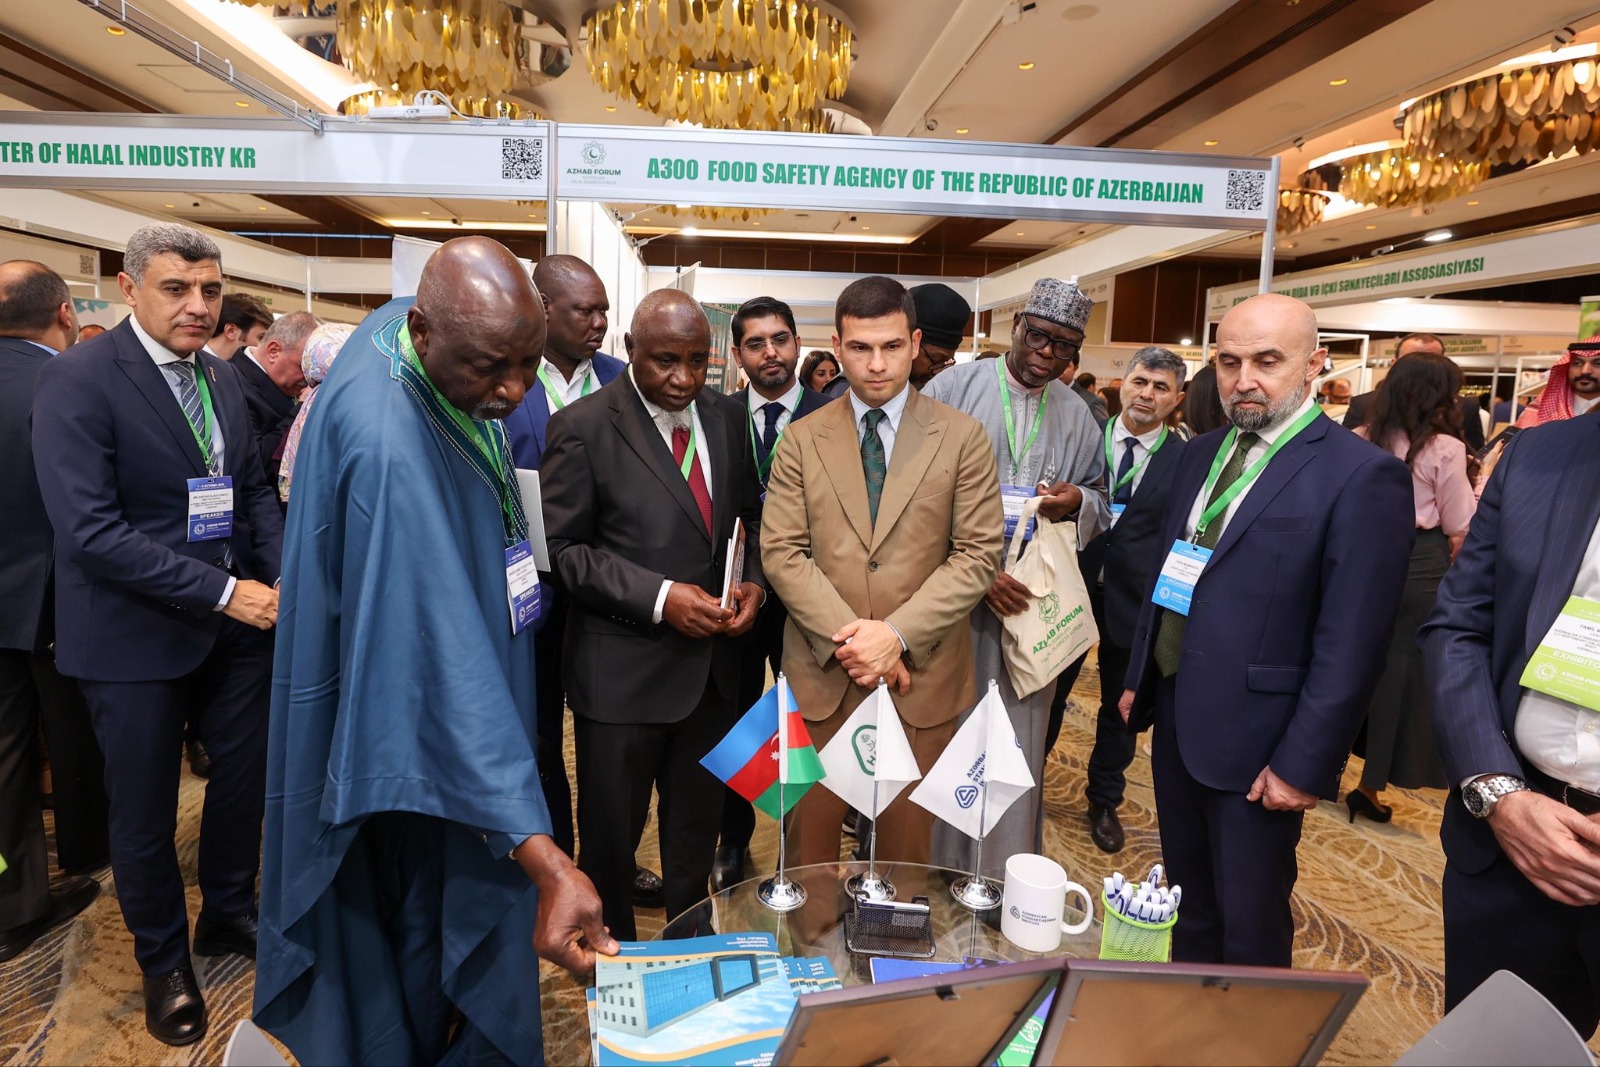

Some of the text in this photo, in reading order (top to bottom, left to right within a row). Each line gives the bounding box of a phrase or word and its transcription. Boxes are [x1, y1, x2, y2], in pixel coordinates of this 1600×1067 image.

[0, 142, 256, 168] TER OF HALAL INDUSTRY KR
[647, 158, 1204, 204] A300 FOOD SAFETY AGENCY OF THE REPUBLIC OF AZERBAIJAN
[1056, 604, 1083, 632] FORUM
